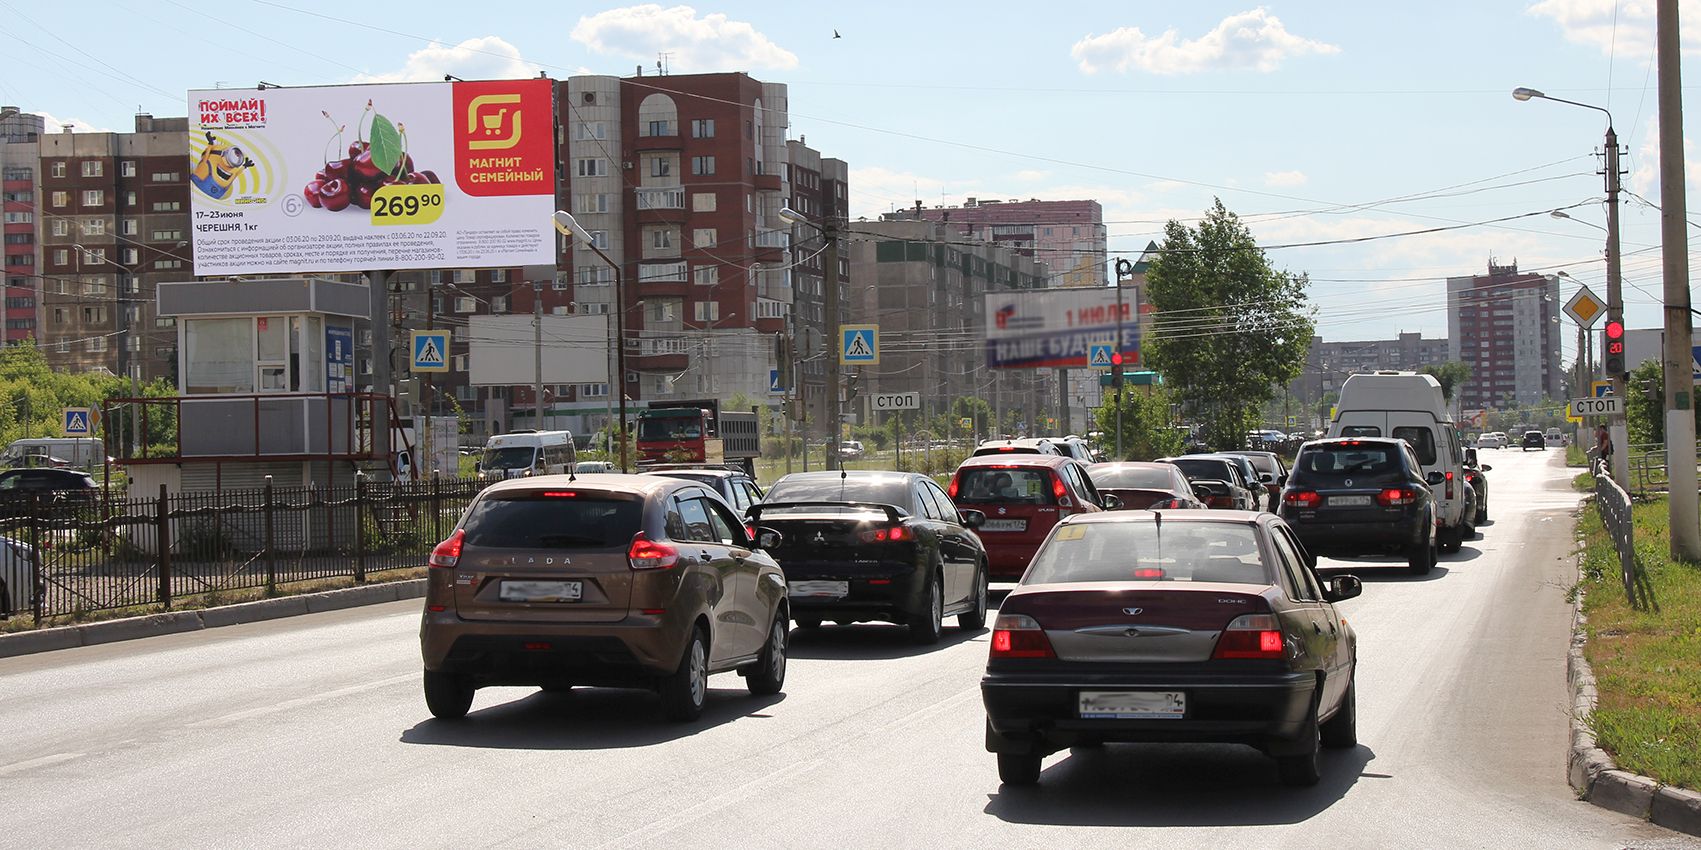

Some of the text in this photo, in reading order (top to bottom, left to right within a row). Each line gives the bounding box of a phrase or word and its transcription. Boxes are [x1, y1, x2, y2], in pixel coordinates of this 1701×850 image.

[200, 97, 258, 112] ПОЙМАЙ
[201, 113, 219, 124] ИХ
[470, 157, 522, 168] МАГНИТ
[470, 168, 544, 182] СЕМЕЙНЫЙ
[374, 194, 441, 216] 269 90
[196, 224, 242, 232] ЧЕРЕШНЯ,
[1049, 329, 1131, 356] БУДУЩЕ
[1609, 342, 1622, 353] 20
[878, 396, 912, 407] СТОП
[1576, 400, 1616, 412] СТОП
